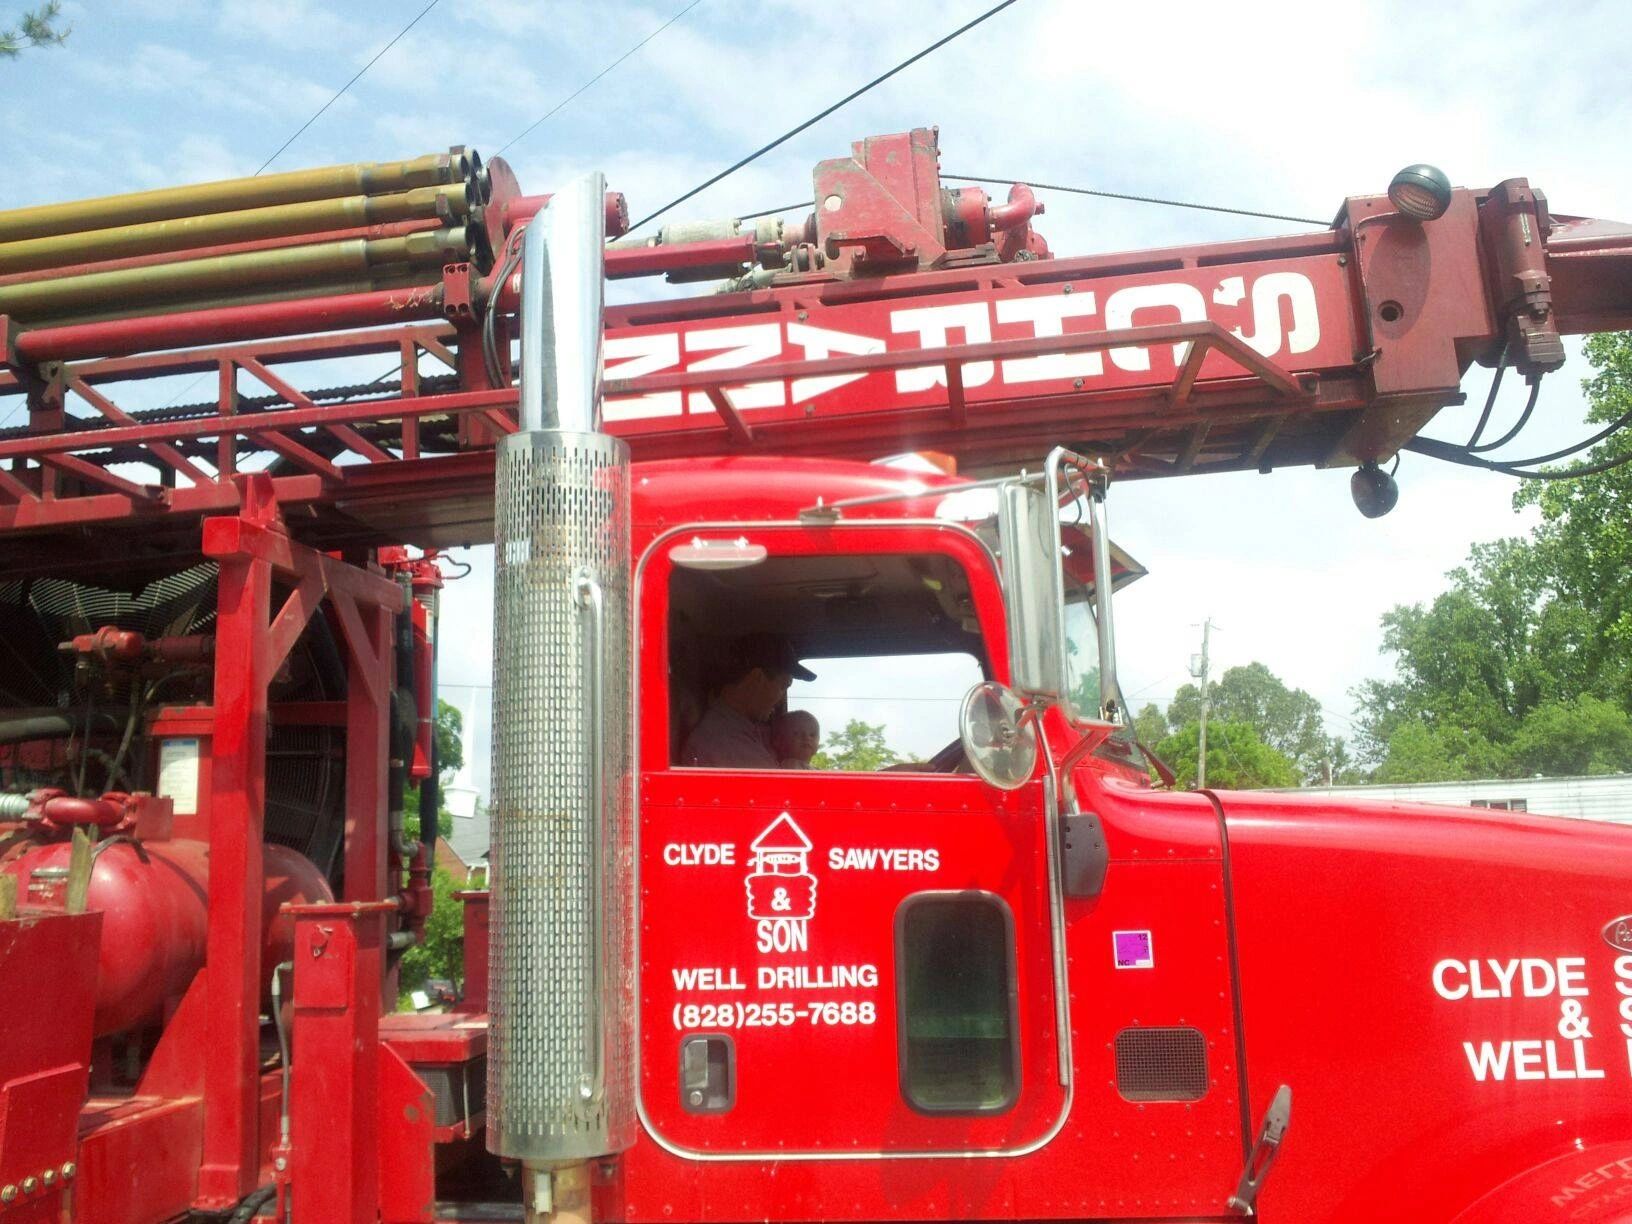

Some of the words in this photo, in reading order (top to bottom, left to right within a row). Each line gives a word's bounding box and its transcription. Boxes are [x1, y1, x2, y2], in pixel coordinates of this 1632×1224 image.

[603, 272, 1321, 423] SCHRAMM
[664, 844, 735, 865] CLYDE
[829, 848, 939, 871] SAWYERS
[771, 888, 791, 911] &
[757, 920, 807, 953] SON
[672, 968, 745, 990] WELL
[758, 965, 878, 989] DRILLING
[1432, 957, 1589, 1000] CLYDE
[673, 1002, 876, 1030] (828)255-7688
[1558, 998, 1592, 1040] &
[1463, 1039, 1605, 1081] WELL
